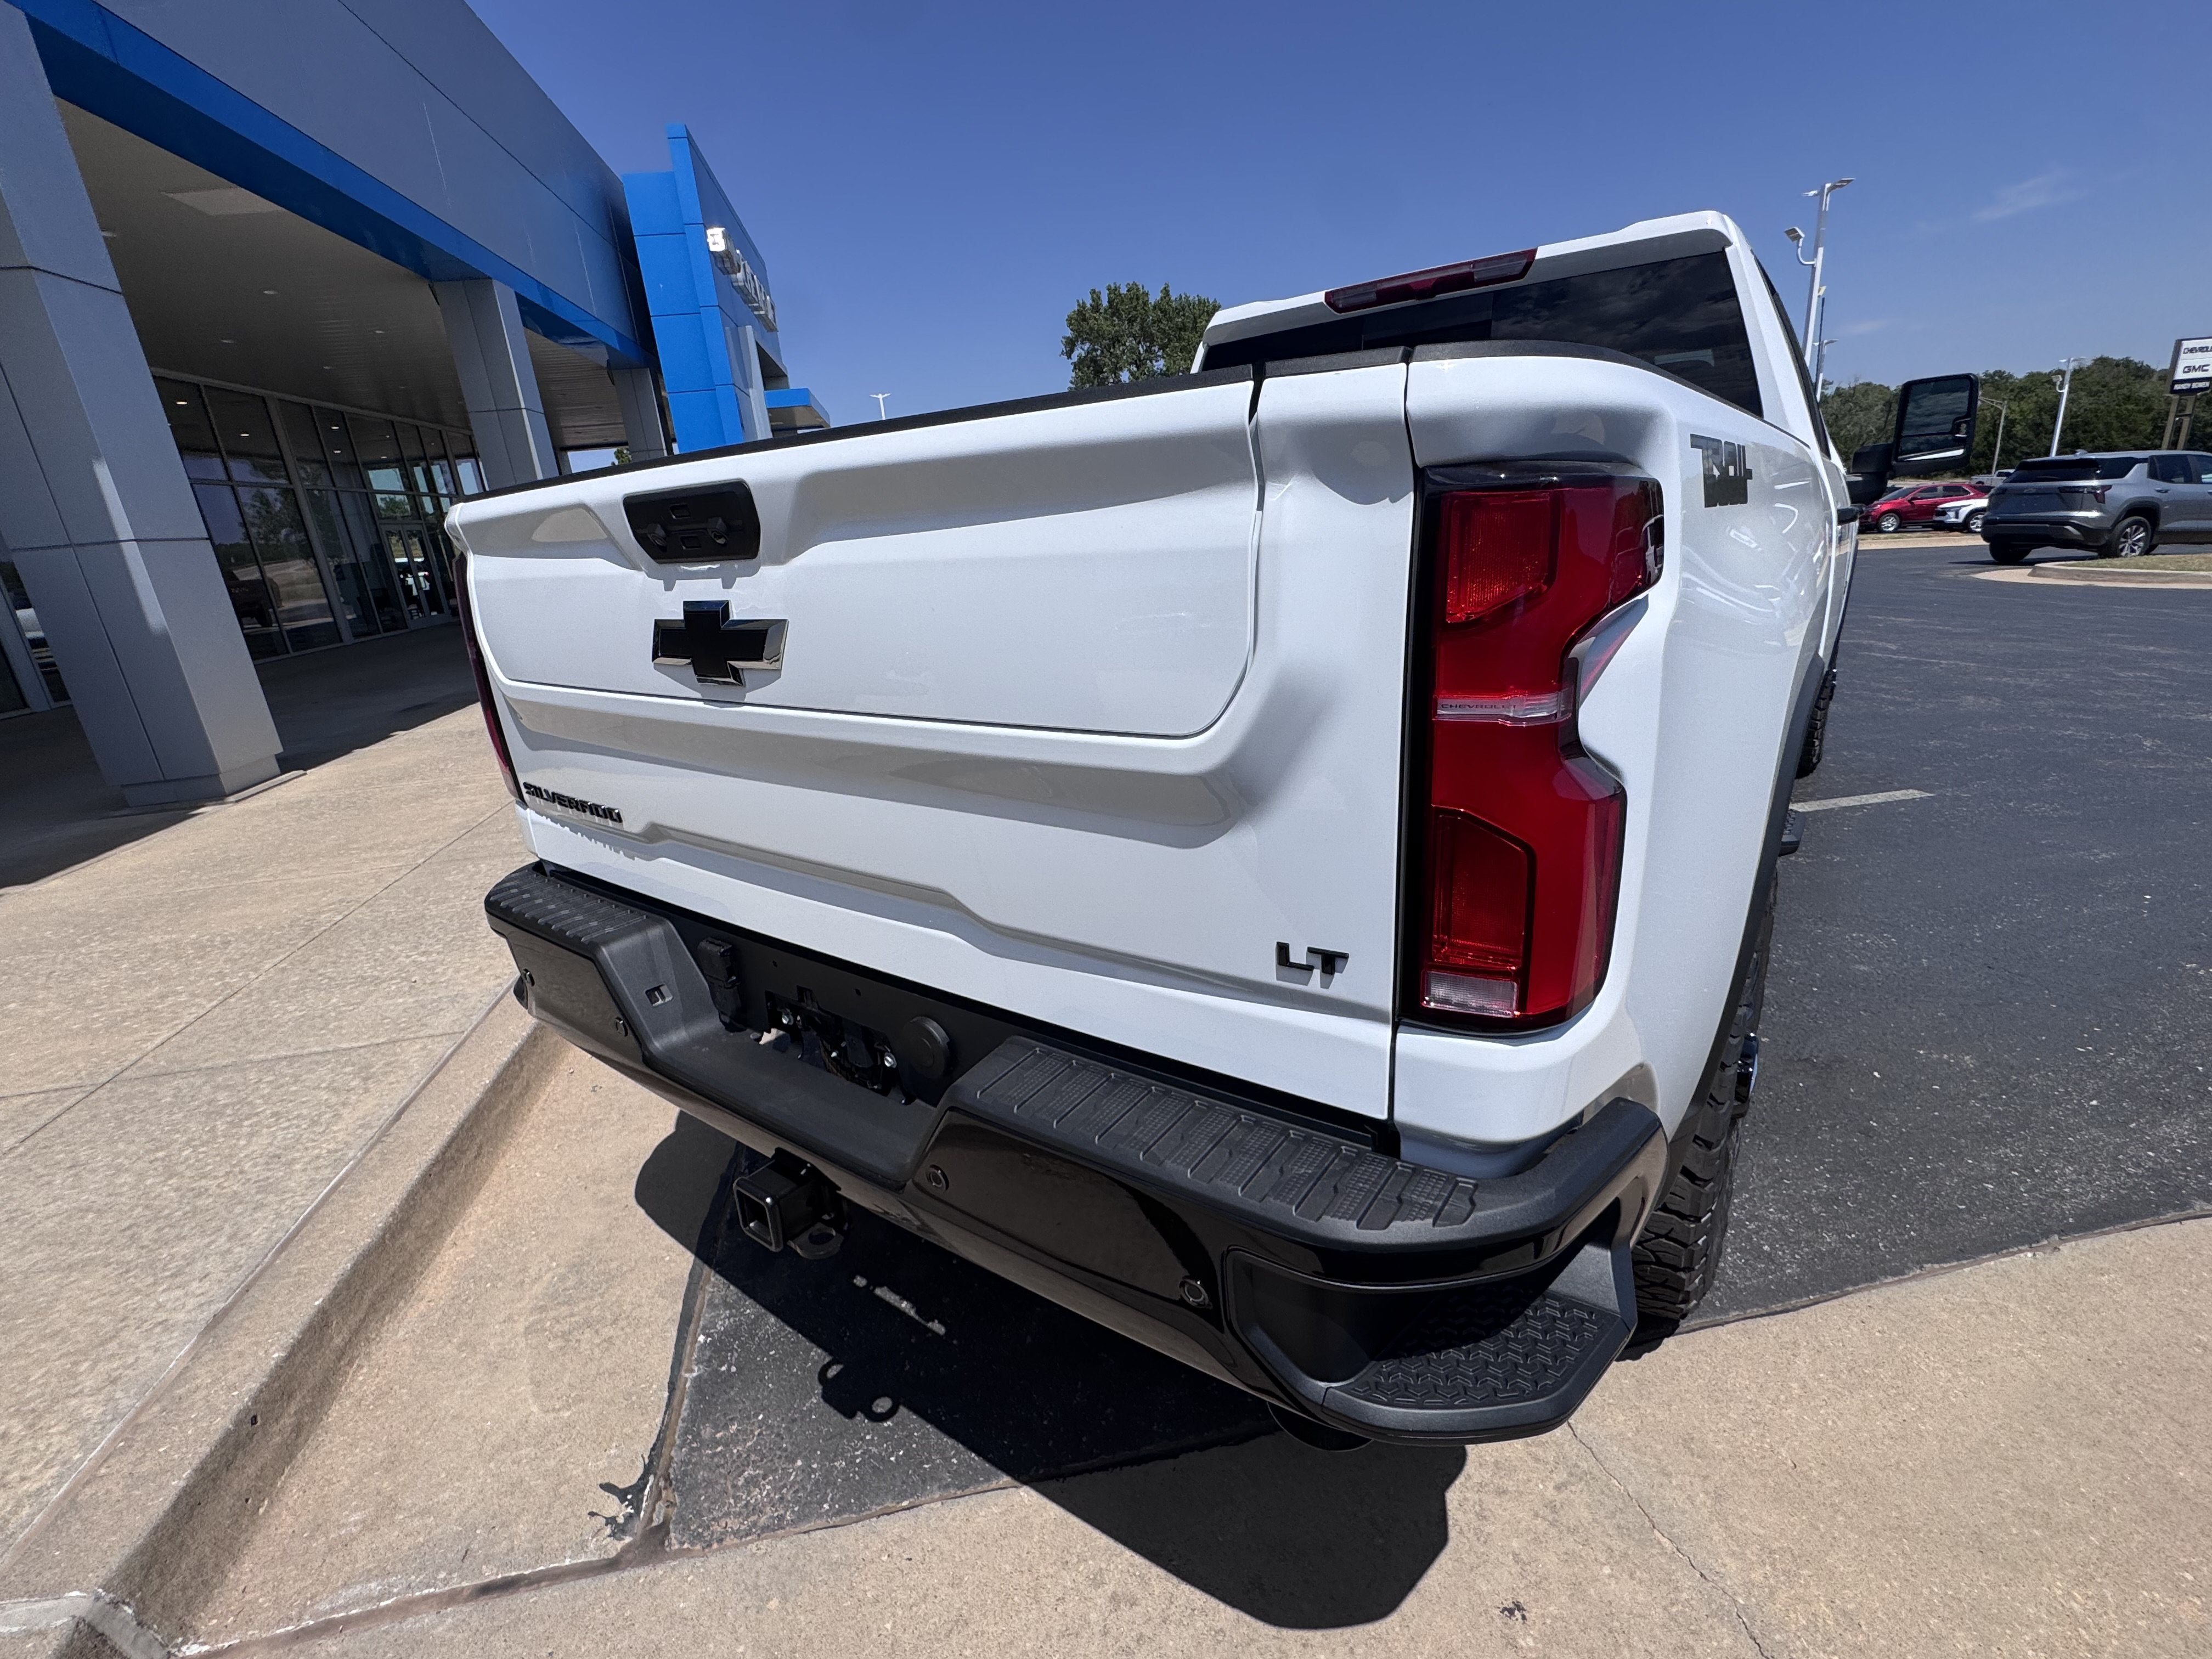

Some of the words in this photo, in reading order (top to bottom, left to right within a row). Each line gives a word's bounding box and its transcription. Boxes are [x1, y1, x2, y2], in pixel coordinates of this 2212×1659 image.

[2183, 364, 2210, 374] GMC
[523, 781, 623, 823] SILVERADO
[1276, 941, 1350, 975] LT
